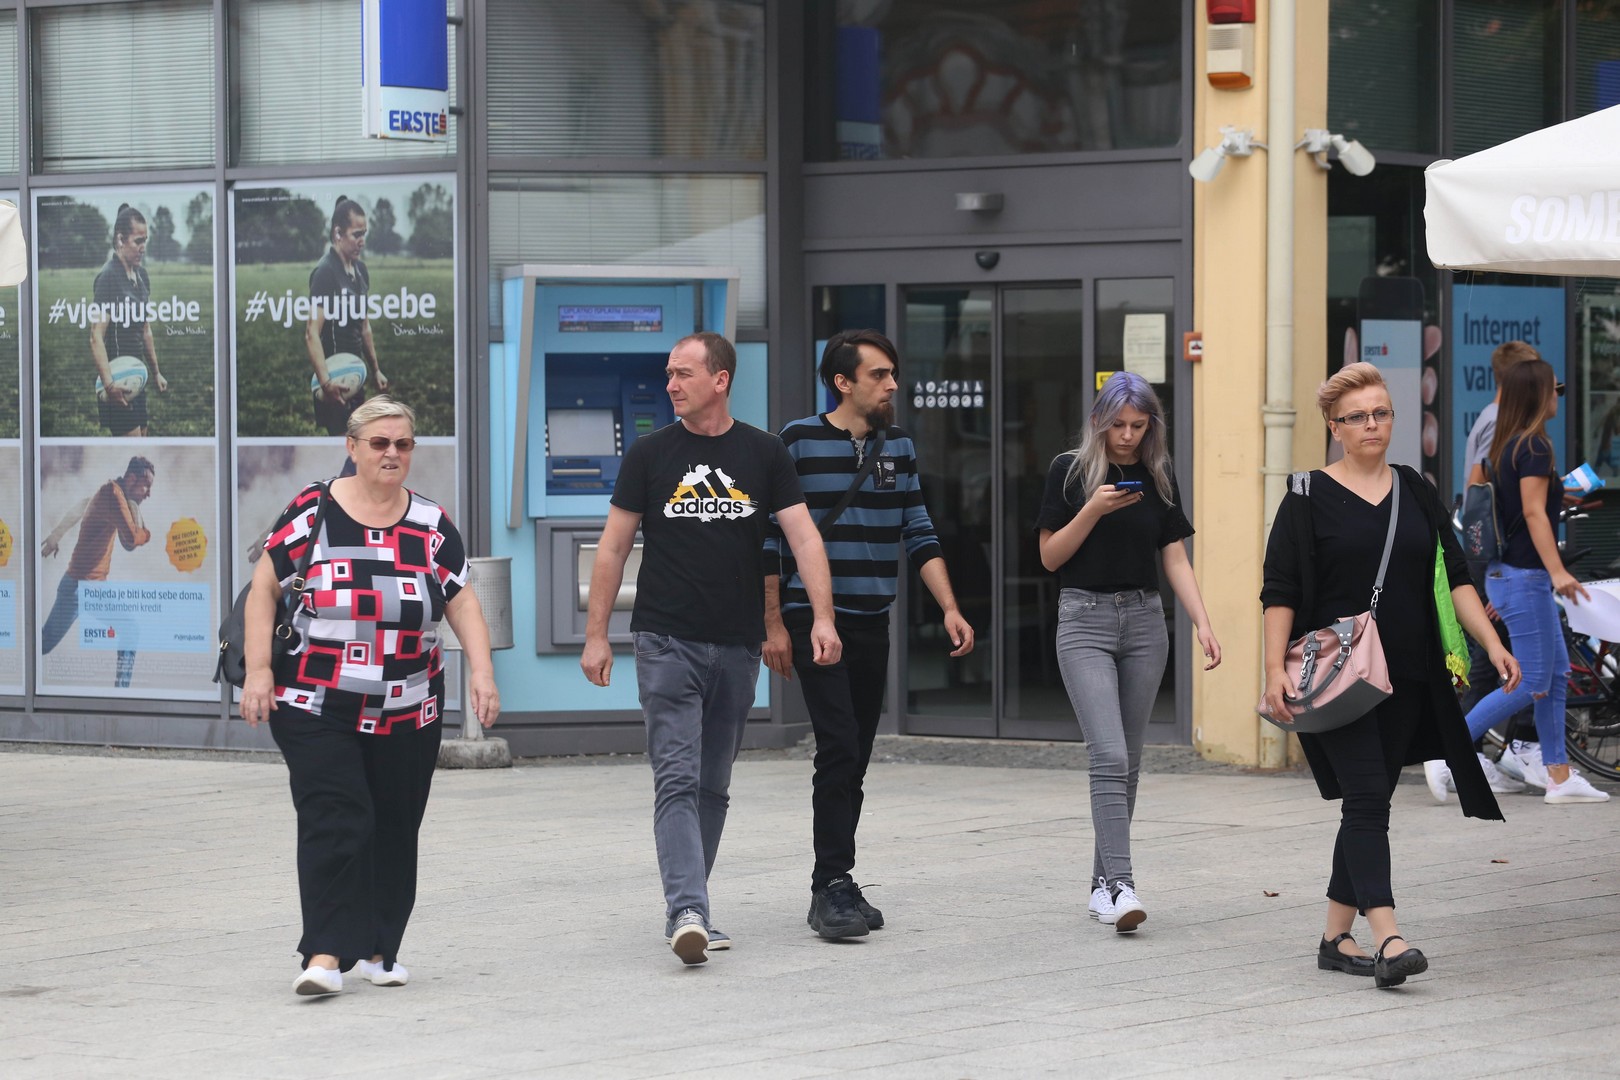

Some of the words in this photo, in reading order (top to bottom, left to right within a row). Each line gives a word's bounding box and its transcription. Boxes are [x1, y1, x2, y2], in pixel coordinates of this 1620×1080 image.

[389, 110, 439, 134] ERSTE
[48, 295, 200, 329] #vjerujusebe
[244, 286, 436, 328] #vjerujusebe
[1463, 312, 1541, 346] Internet
[1364, 346, 1381, 356] ERSTE
[671, 498, 744, 514] adidas
[84, 588, 116, 601] Pobjeda
[118, 589, 125, 601] je
[127, 589, 140, 599] biti
[141, 589, 157, 600] kod
[158, 590, 178, 600] sebe
[179, 590, 205, 601] doma.
[84, 603, 103, 612] Erste
[105, 603, 139, 612] stambeni
[140, 603, 162, 613] kredit
[84, 628, 106, 638] ERSTE
